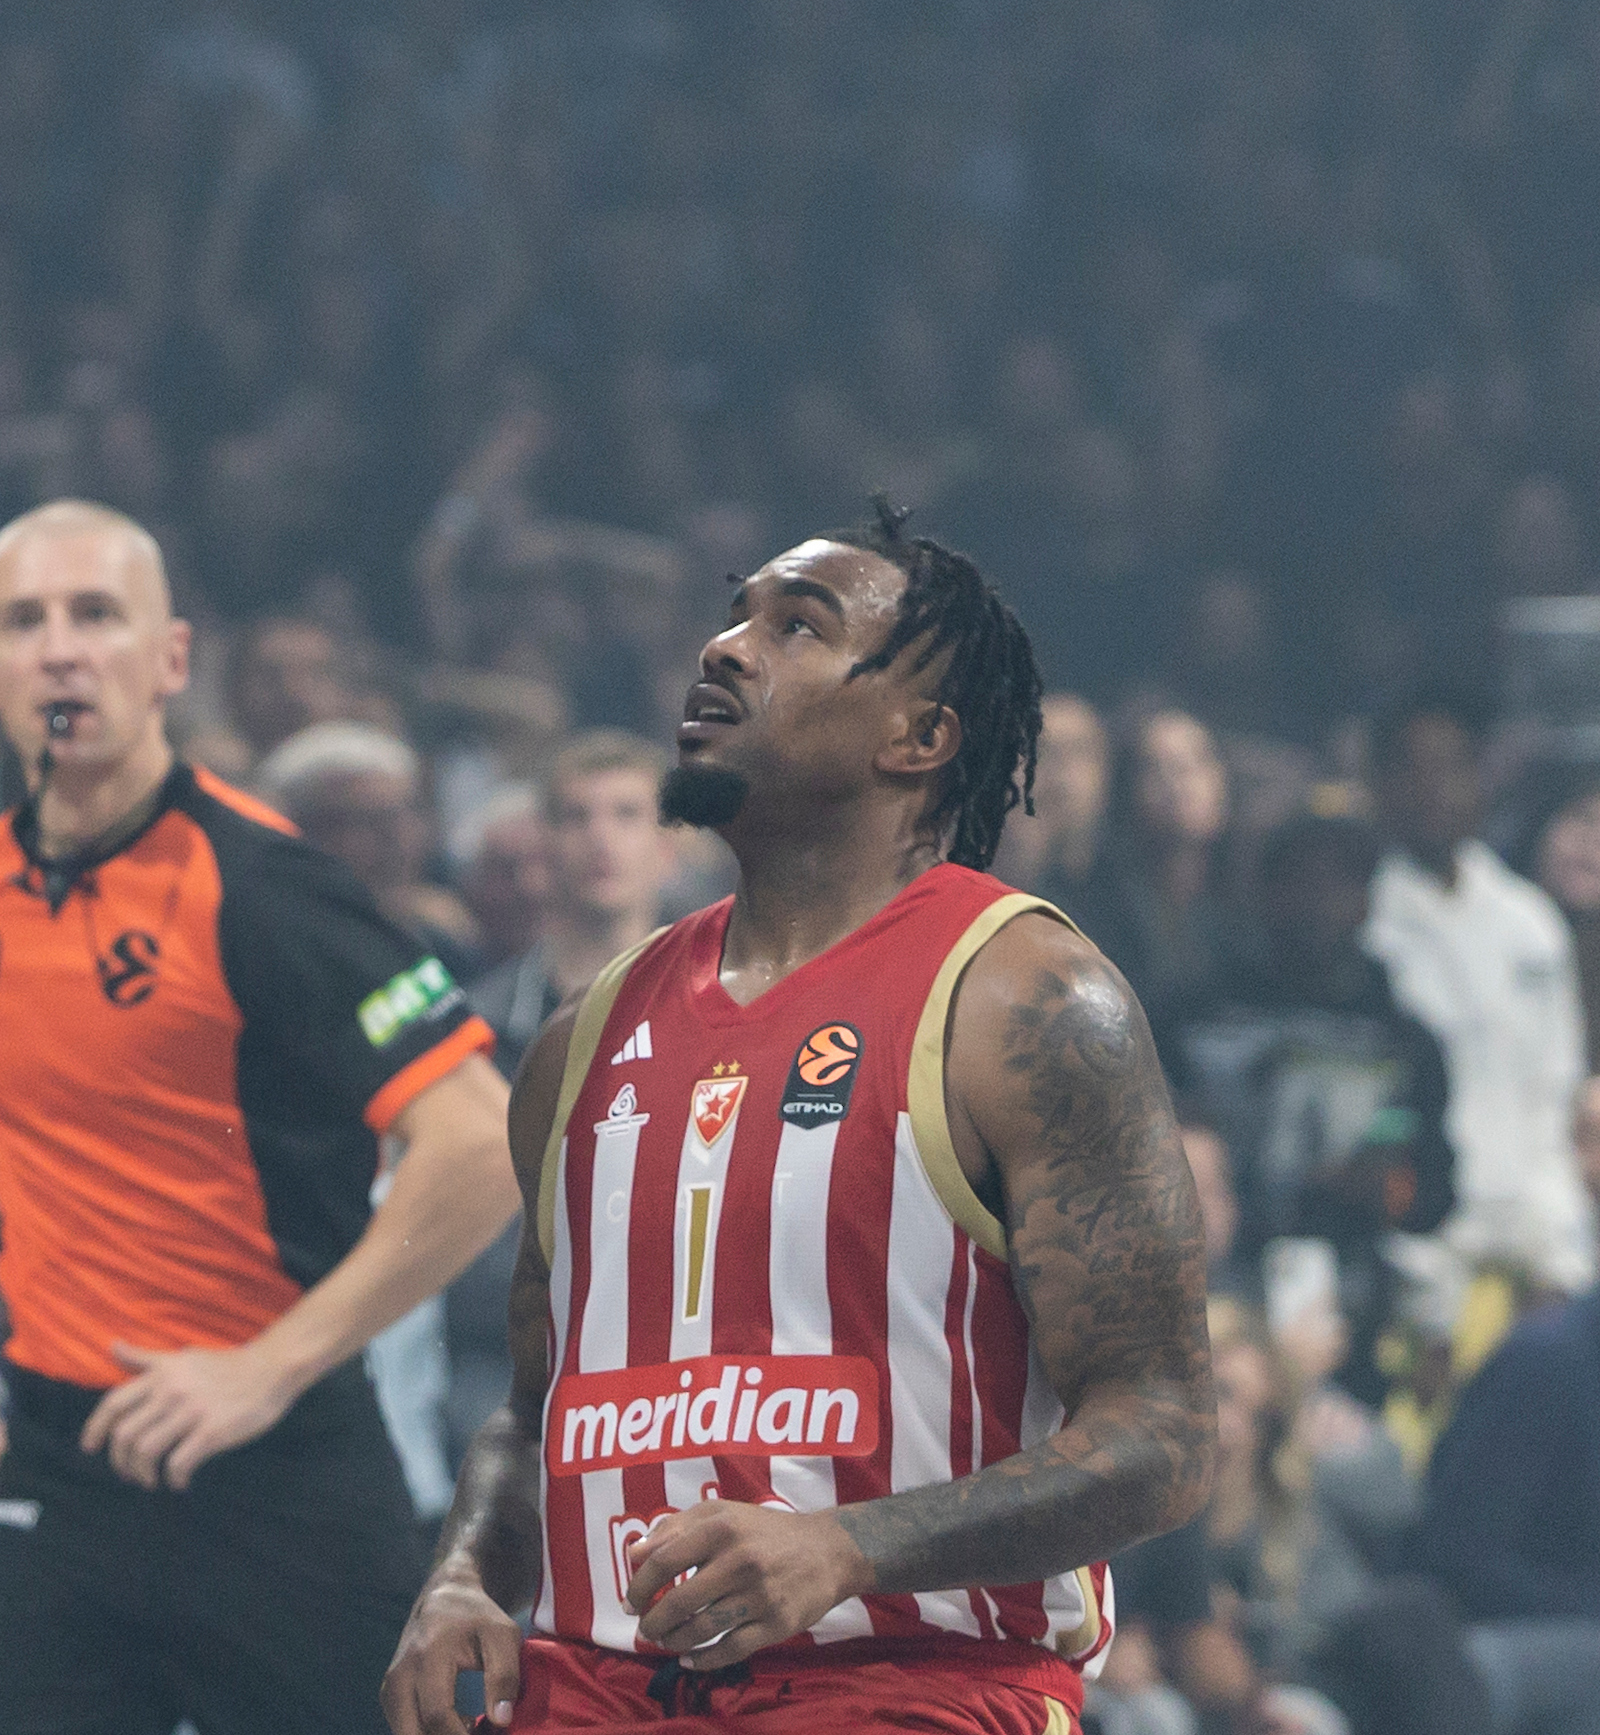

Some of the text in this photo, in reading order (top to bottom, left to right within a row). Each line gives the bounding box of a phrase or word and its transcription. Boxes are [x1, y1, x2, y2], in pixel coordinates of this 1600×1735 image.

[783, 1102, 843, 1114] ETIHAD
[683, 1184, 716, 1323] 1
[562, 1365, 859, 1464] meridian
